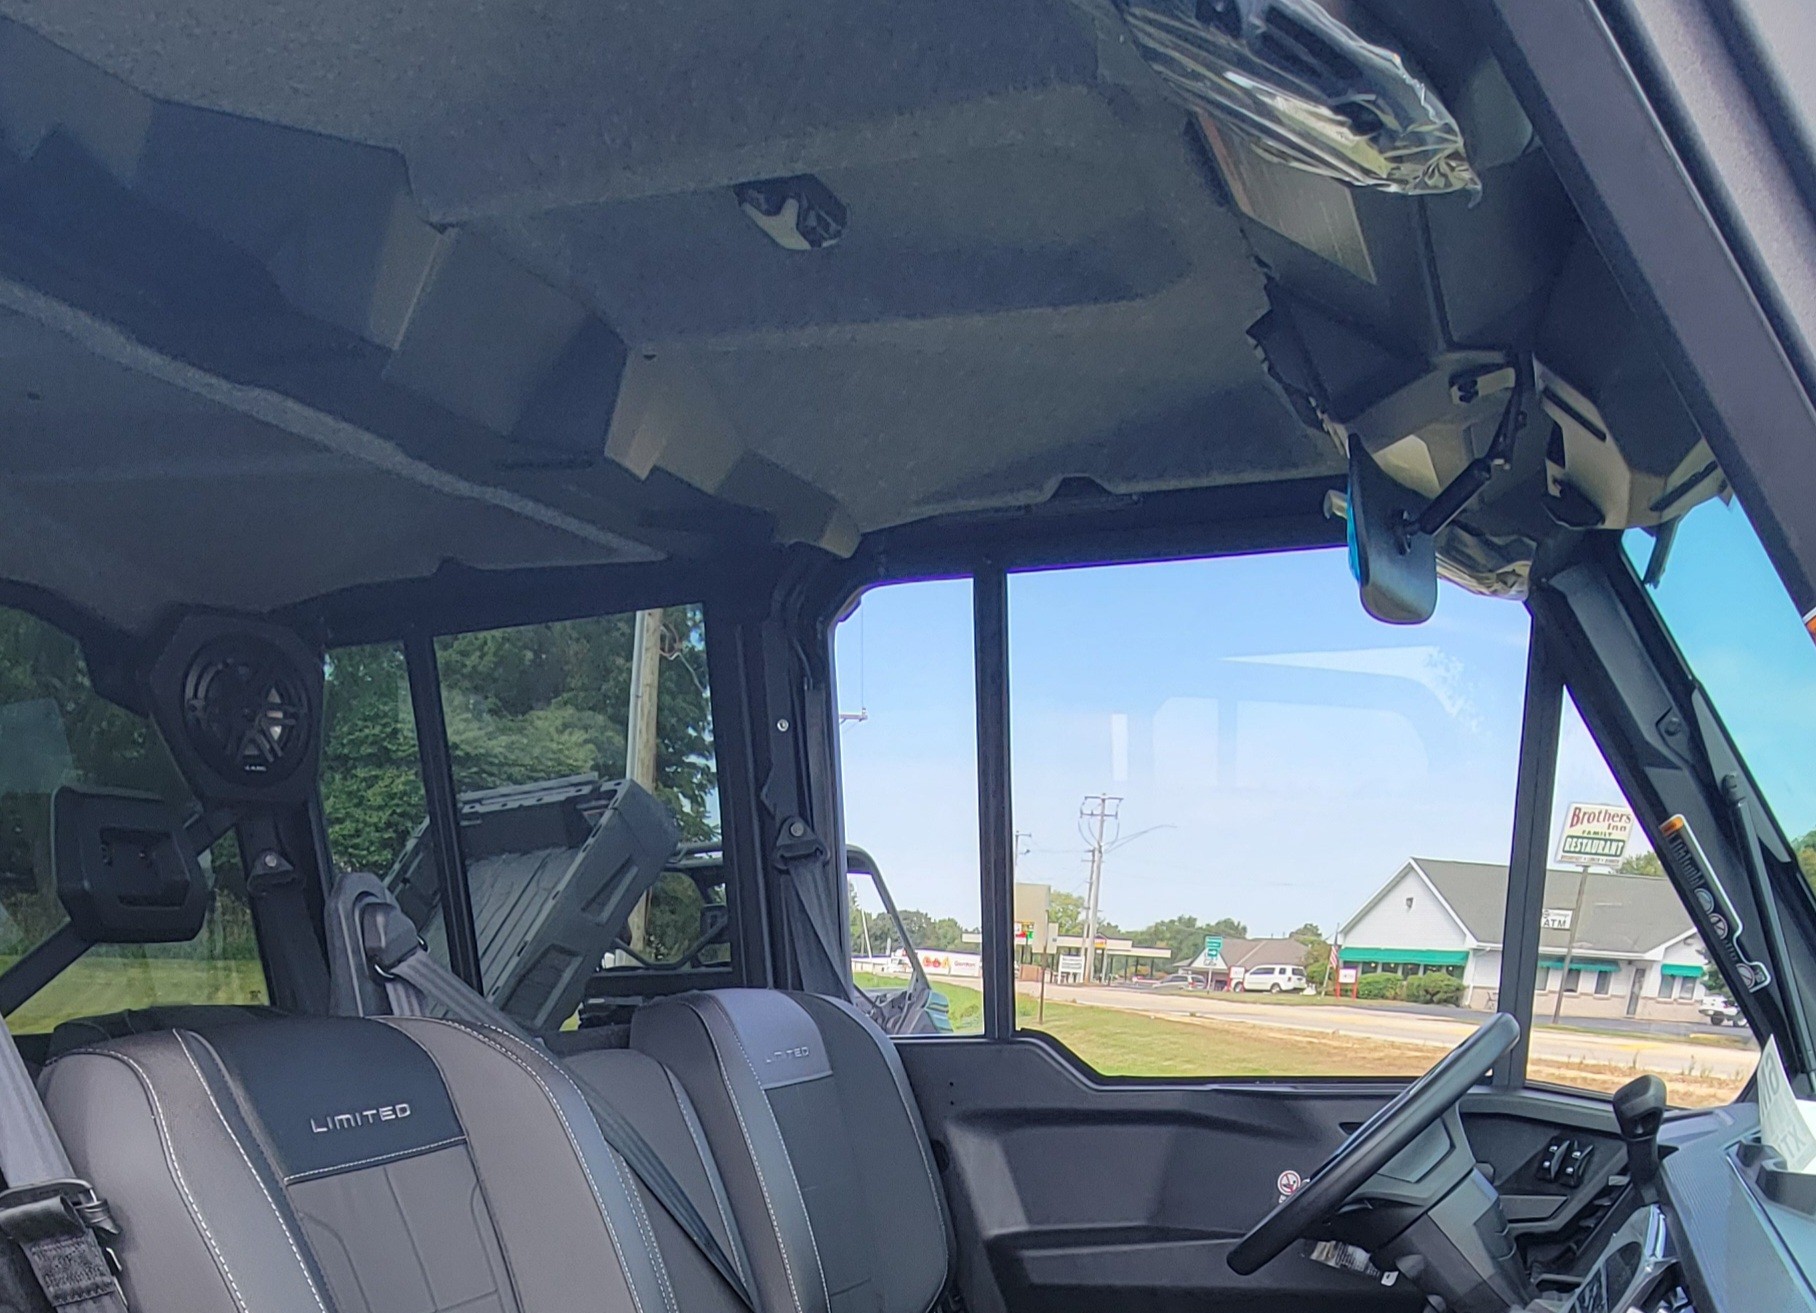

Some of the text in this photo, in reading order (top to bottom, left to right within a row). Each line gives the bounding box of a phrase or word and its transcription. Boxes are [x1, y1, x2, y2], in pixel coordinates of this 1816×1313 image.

[1569, 806, 1633, 828] Brothers
[1581, 829, 1613, 837] FAMILY
[1607, 823, 1627, 832] Inn
[1563, 838, 1624, 856] RESTAURANT
[1543, 918, 1567, 927] ATM
[766, 1046, 809, 1063] LMTED
[310, 1103, 411, 1133] LIMITED
